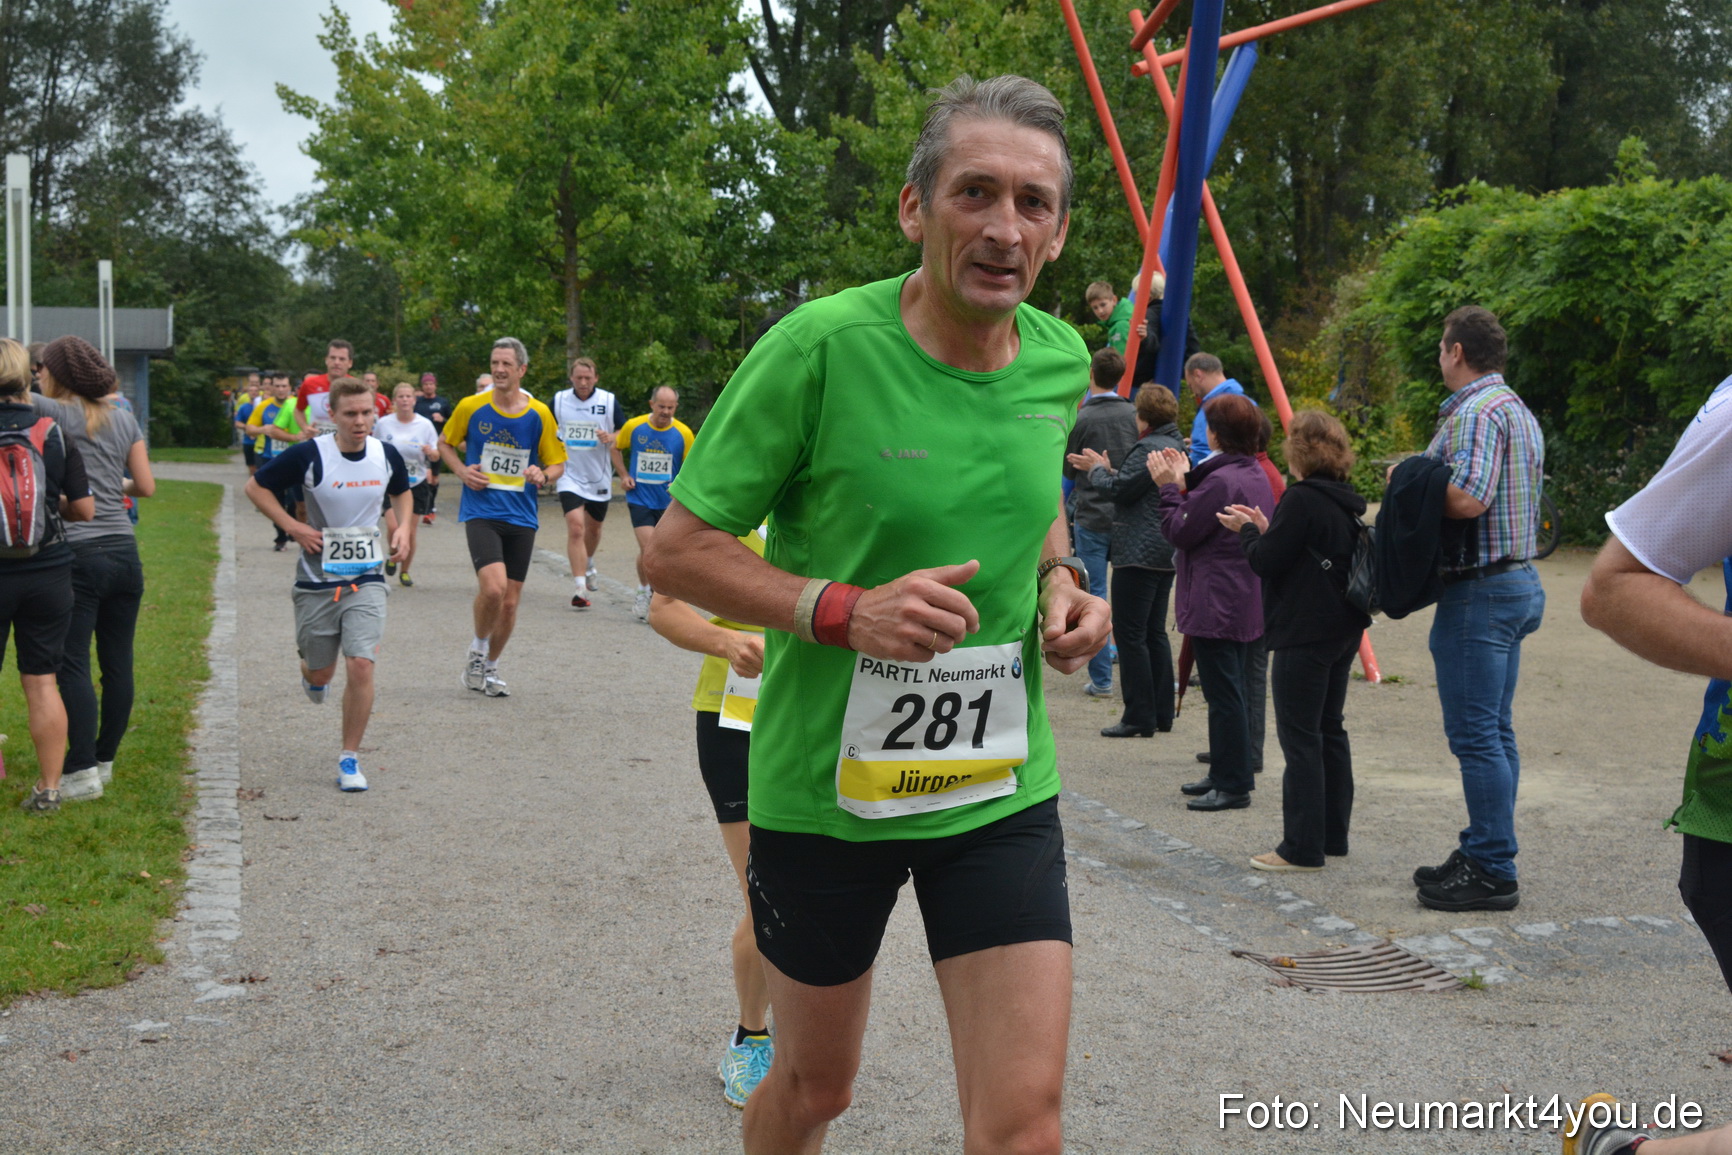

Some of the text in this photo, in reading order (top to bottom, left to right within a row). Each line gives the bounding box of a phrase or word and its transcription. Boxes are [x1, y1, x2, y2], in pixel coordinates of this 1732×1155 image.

[591, 405, 606, 415] 13
[568, 427, 594, 439] 2571
[896, 449, 929, 459] JAKO
[491, 456, 521, 475] 645
[640, 460, 668, 473] 3424
[329, 539, 375, 560] 2551
[860, 657, 1006, 683] PARTL Neumarkt
[881, 689, 993, 751] 281
[847, 746, 855, 758] C
